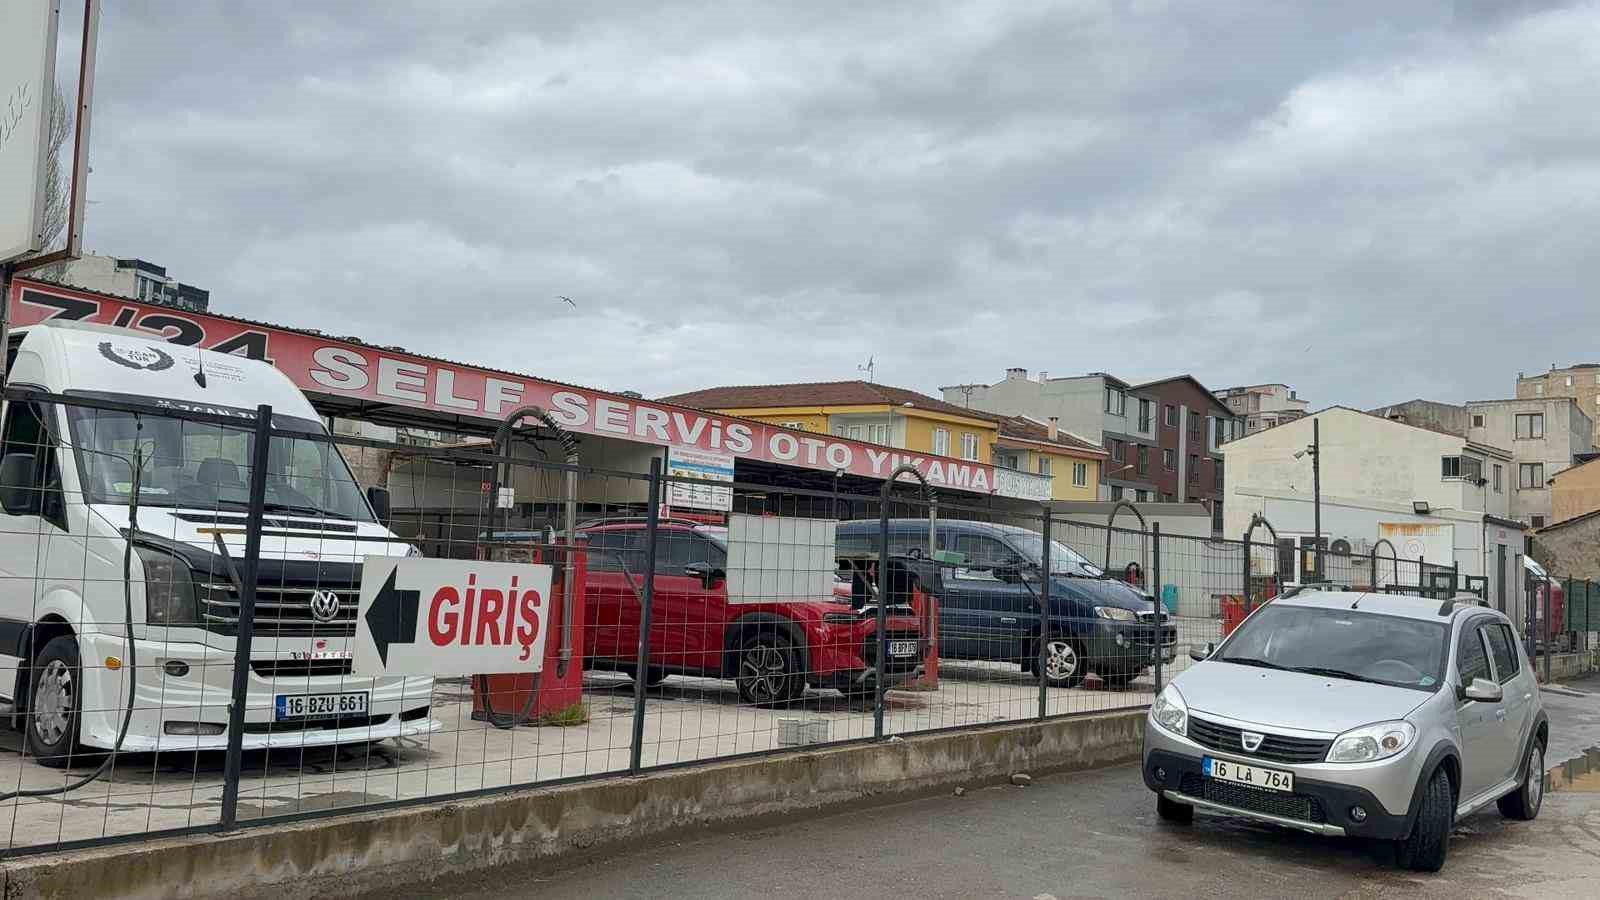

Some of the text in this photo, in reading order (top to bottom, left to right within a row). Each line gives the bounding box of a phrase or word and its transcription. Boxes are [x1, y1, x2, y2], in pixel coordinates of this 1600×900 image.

[310, 346, 525, 414] SELF
[769, 433, 853, 469] OTO
[428, 574, 541, 661] GİRİŞ
[289, 698, 303, 714] 16
[309, 697, 334, 713] BZU
[340, 695, 363, 711] 661
[1214, 762, 1226, 777] 16
[1236, 766, 1252, 782] LA
[1264, 771, 1290, 789] 764
